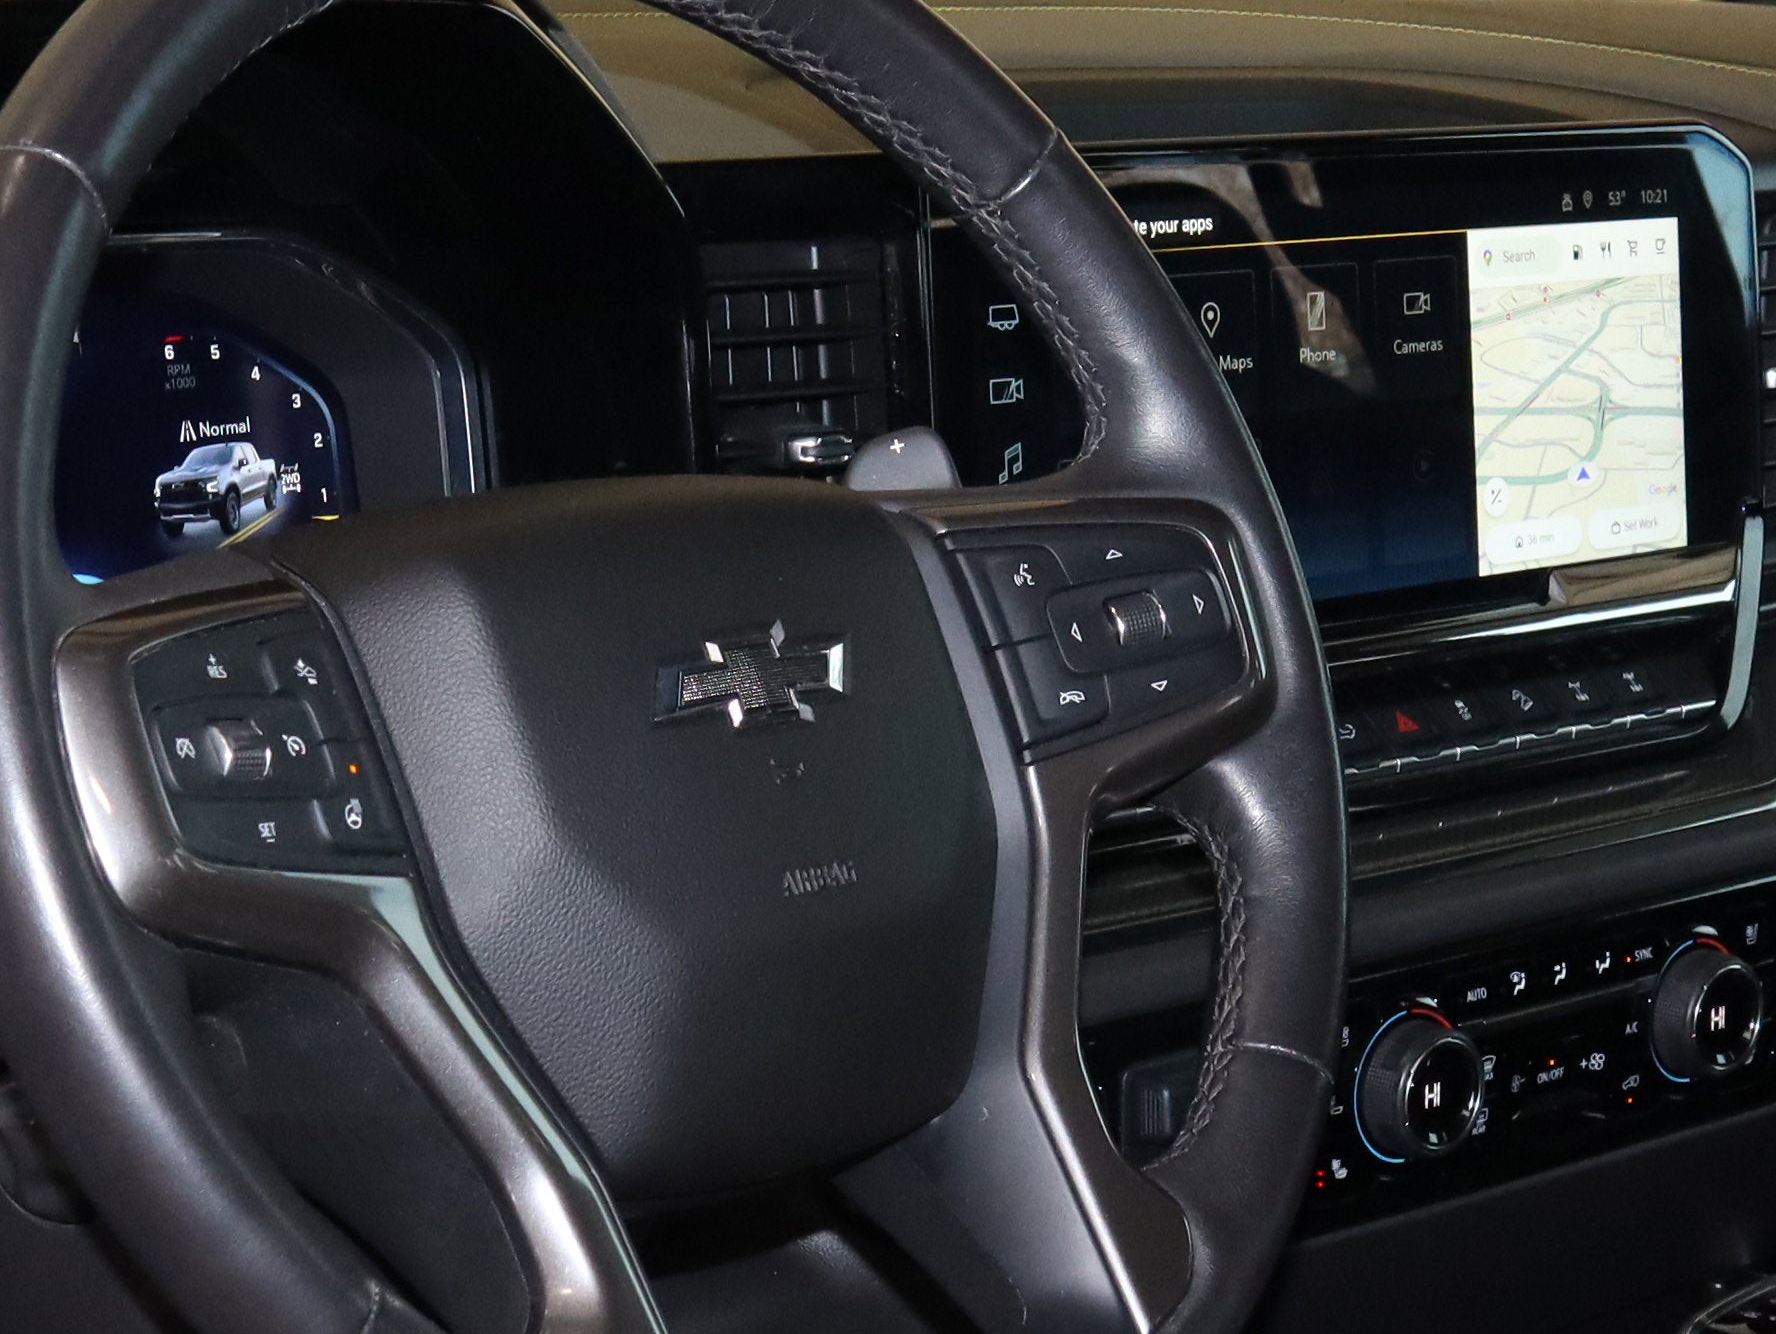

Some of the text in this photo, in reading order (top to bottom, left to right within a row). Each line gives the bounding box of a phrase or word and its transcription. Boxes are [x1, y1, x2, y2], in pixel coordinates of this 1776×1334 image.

[1641, 188, 1668, 204] 10:21
[1150, 219, 1179, 238] your
[1181, 217, 1214, 236] apps
[1502, 249, 1536, 263] Search
[164, 344, 175, 360] 6
[209, 344, 221, 360] 5
[1299, 347, 1336, 363] Phone
[1393, 339, 1444, 355] Cameras
[166, 364, 191, 376] RPM
[1219, 355, 1254, 372] Maps
[250, 365, 261, 381] 4
[291, 393, 302, 409] 3
[199, 416, 251, 438] Normal
[313, 433, 324, 448] 2
[1466, 987, 1488, 1003] AUTO
[1710, 1005, 1726, 1032] HI
[1536, 1066, 1565, 1084] ON/OFF
[1424, 1081, 1441, 1110] HI
